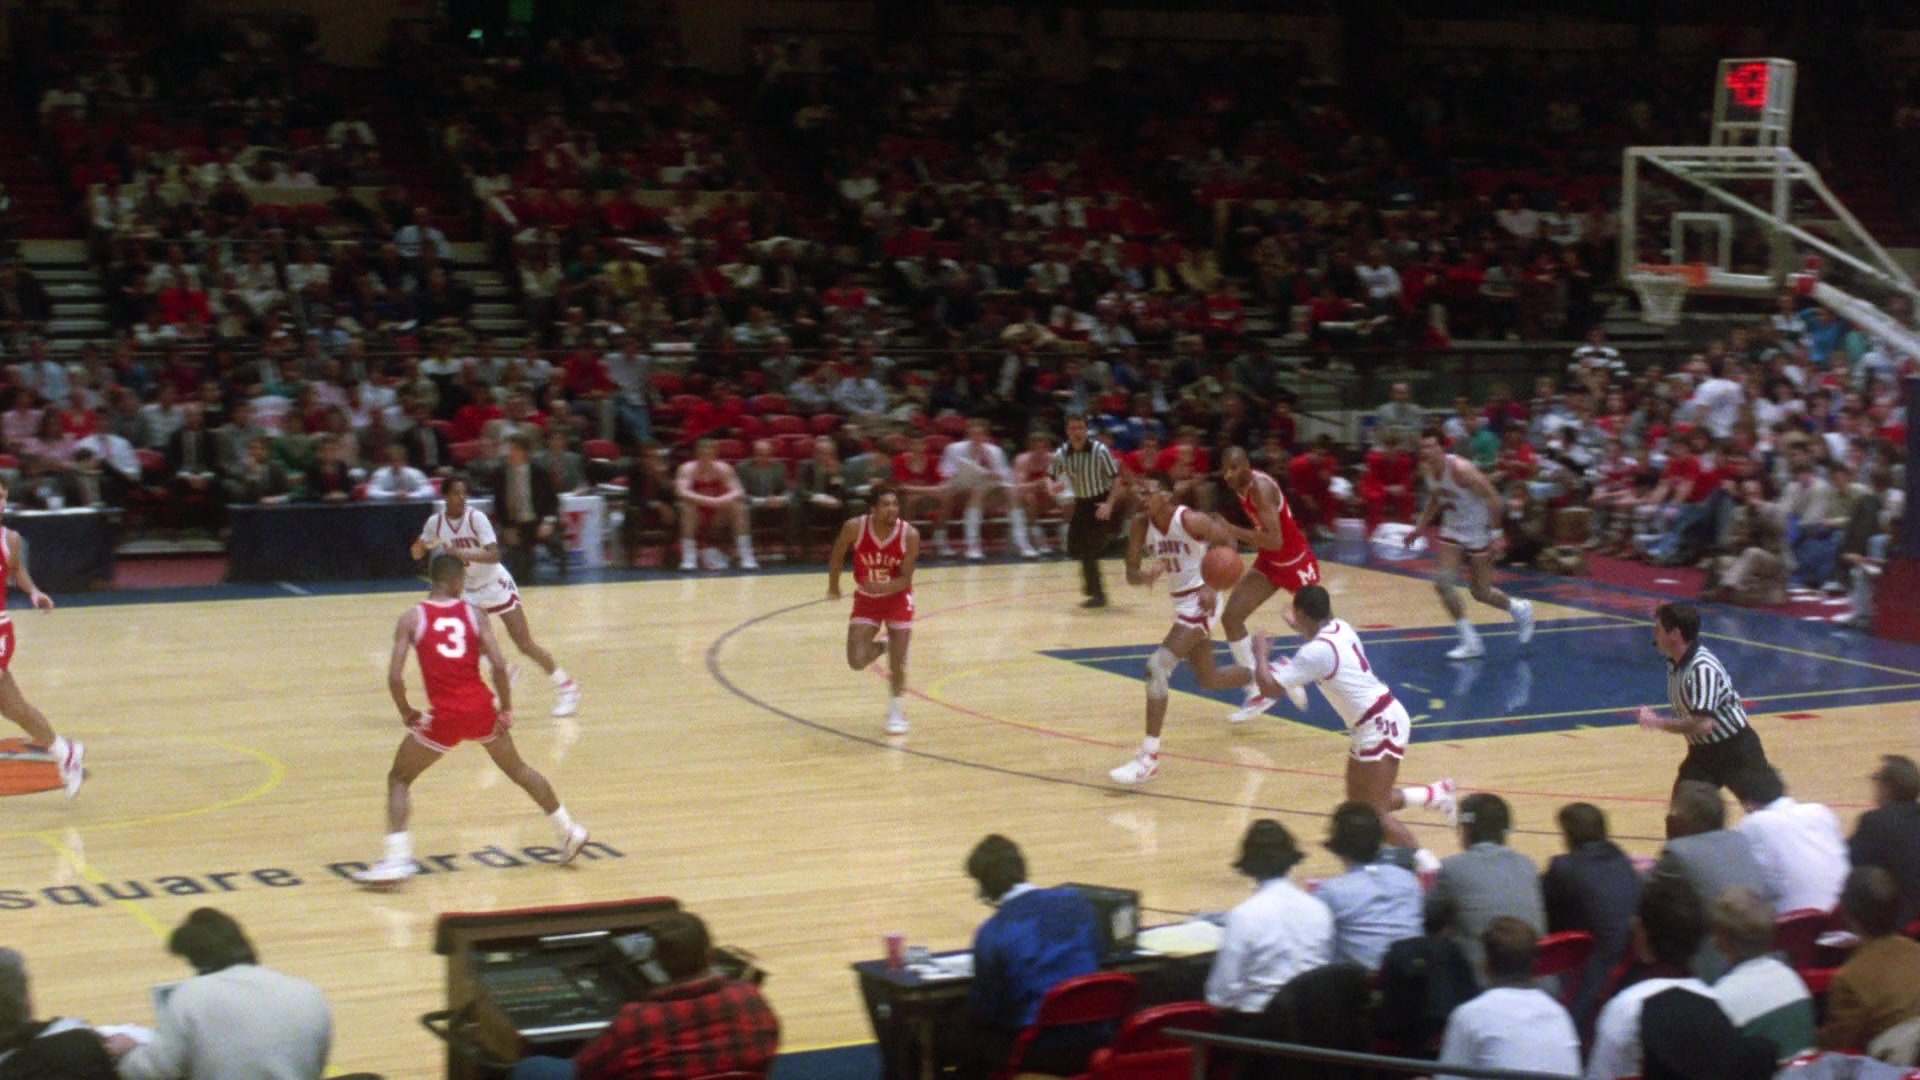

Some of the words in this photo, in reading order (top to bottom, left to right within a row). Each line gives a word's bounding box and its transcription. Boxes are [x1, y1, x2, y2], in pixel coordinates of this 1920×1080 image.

[1297, 562, 1317, 586] M
[433, 617, 467, 659] 3
[0, 868, 303, 910] square
